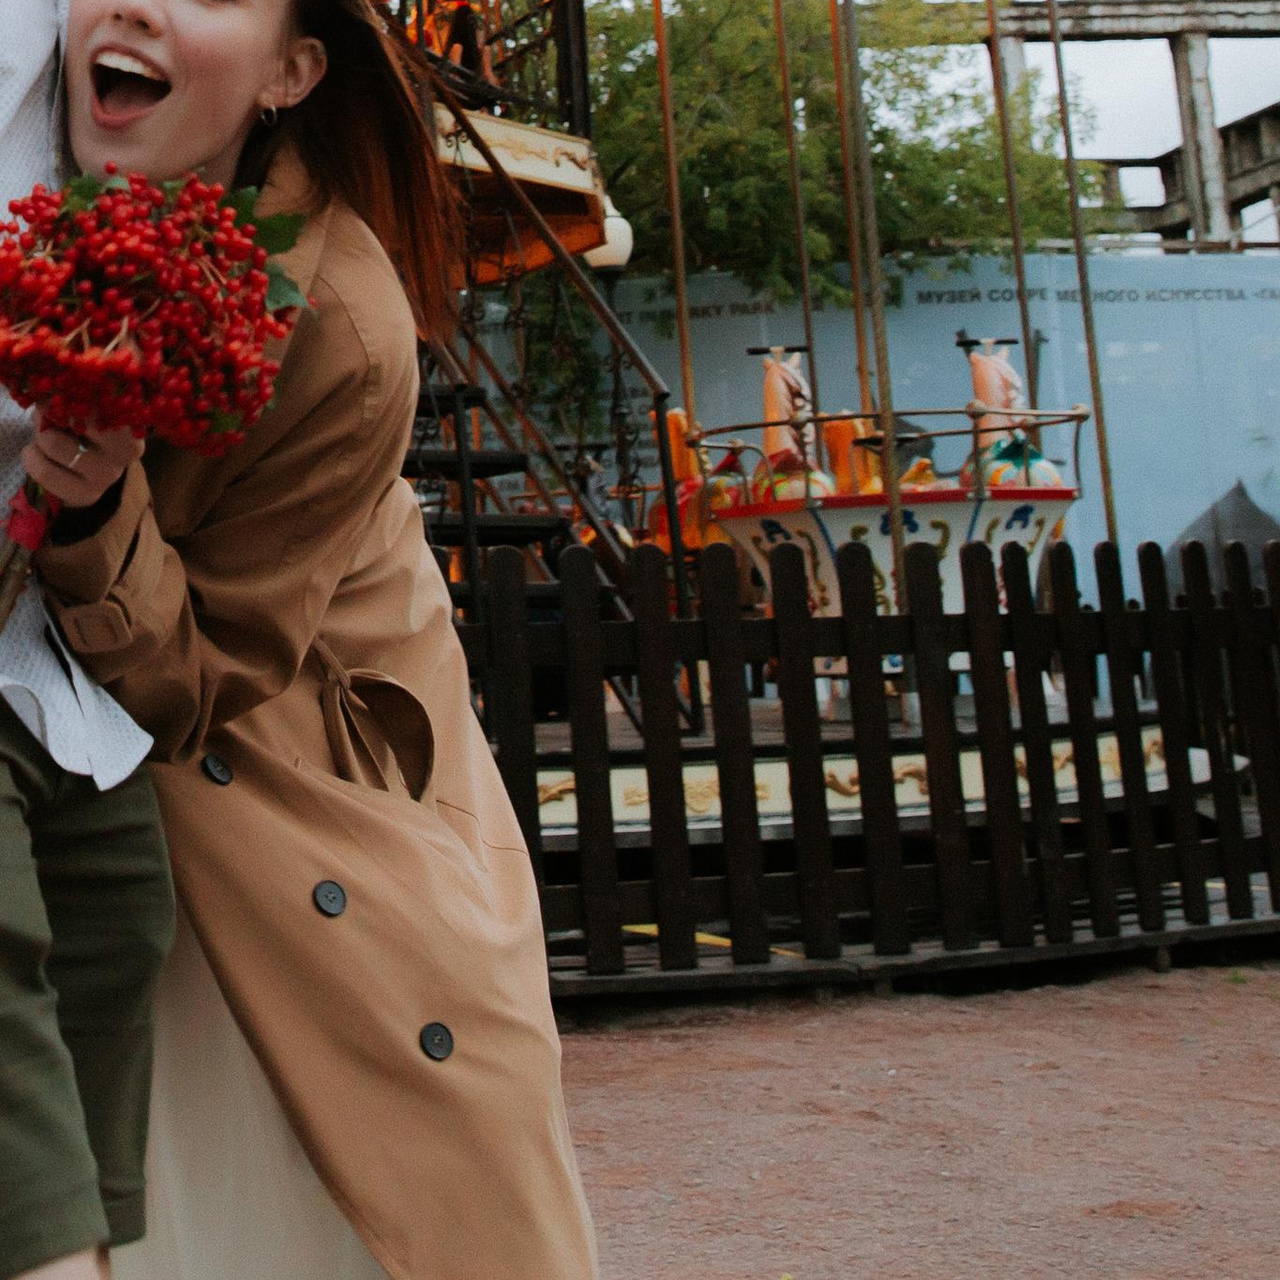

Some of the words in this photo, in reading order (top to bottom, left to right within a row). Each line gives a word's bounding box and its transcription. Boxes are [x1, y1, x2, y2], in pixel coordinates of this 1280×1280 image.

[916, 286, 982, 303] МУЗЕЙ
[987, 287, 1140, 303] СОРЕМЕНОГО
[1146, 288, 1247, 302] ИСКУССТВА
[728, 300, 775, 317] PARK
